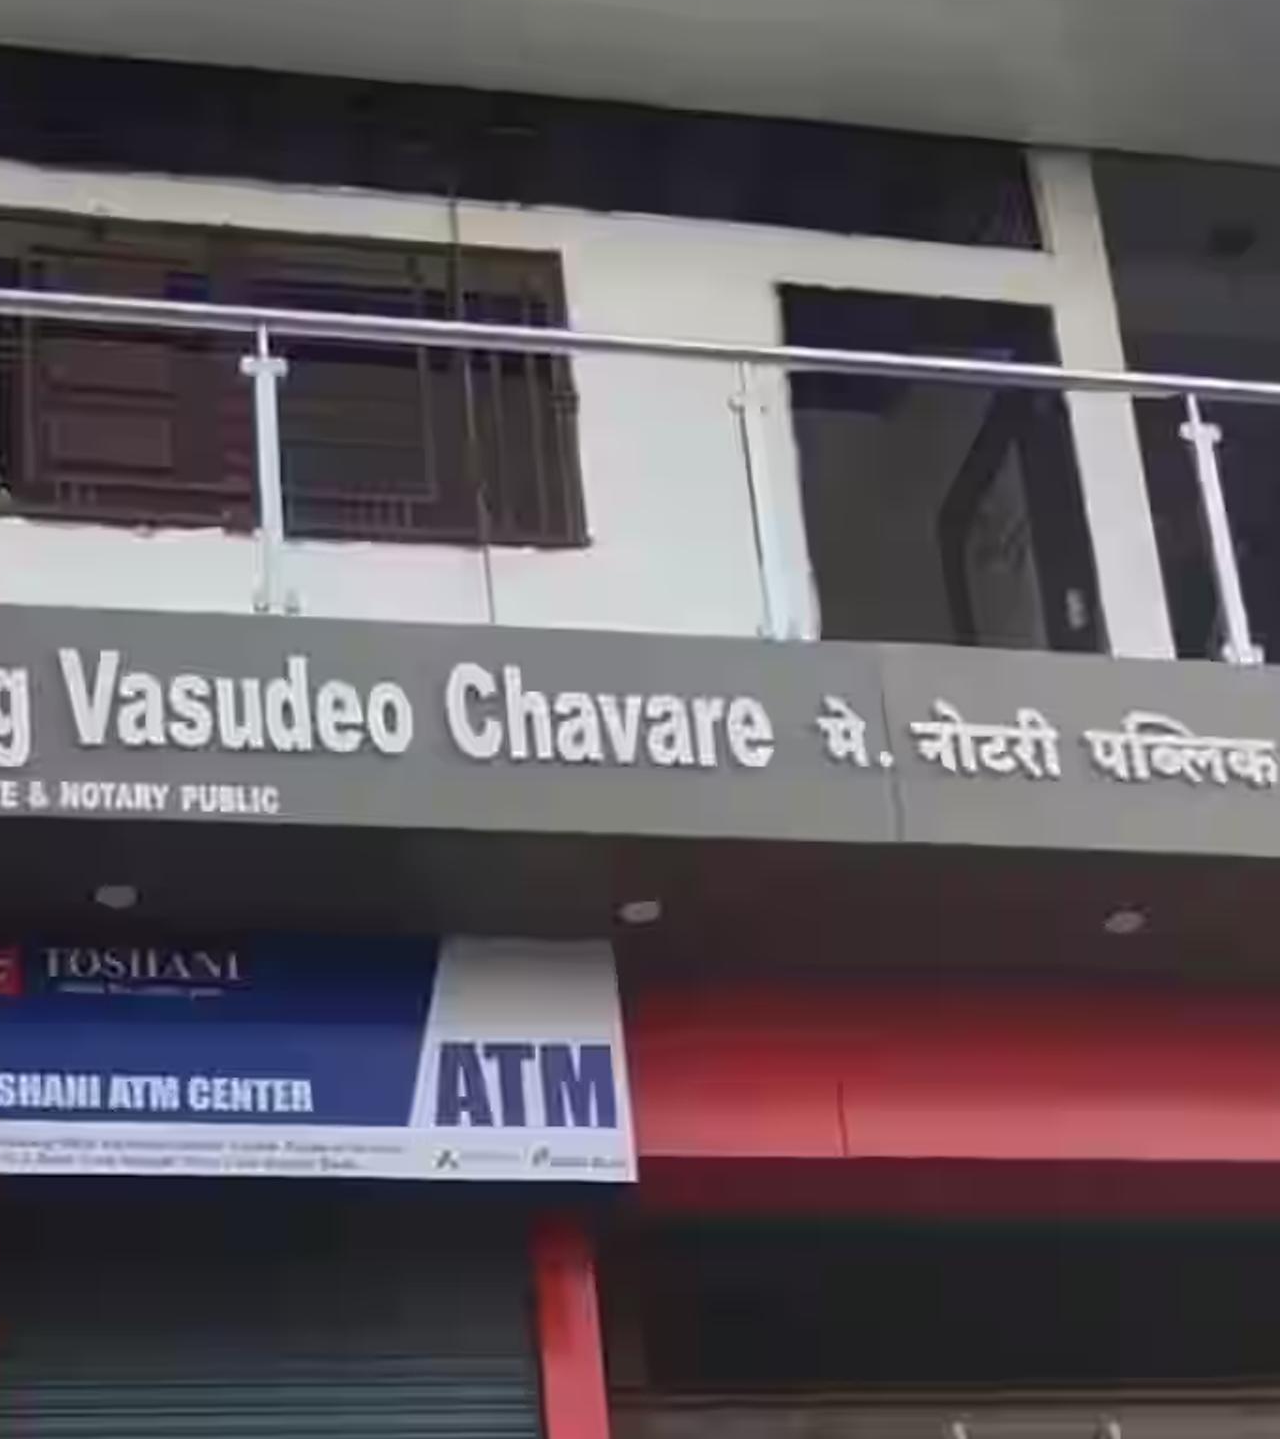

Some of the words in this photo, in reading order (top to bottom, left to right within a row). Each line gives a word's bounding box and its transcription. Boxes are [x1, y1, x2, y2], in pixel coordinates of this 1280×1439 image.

[58, 647, 413, 755] Vasudeo
[445, 662, 776, 767] Chavare
[910, 699, 1060, 775] नोटरी
[1083, 711, 1279, 783] पब्लिक
[28, 780, 48, 807] &
[60, 781, 170, 811] NOTARY
[180, 785, 281, 814] PUBLIC
[42, 946, 241, 981] TOSHANI
[108, 1075, 180, 1111] ATM
[187, 1077, 314, 1112] CENTER
[434, 1043, 617, 1129] ATM
